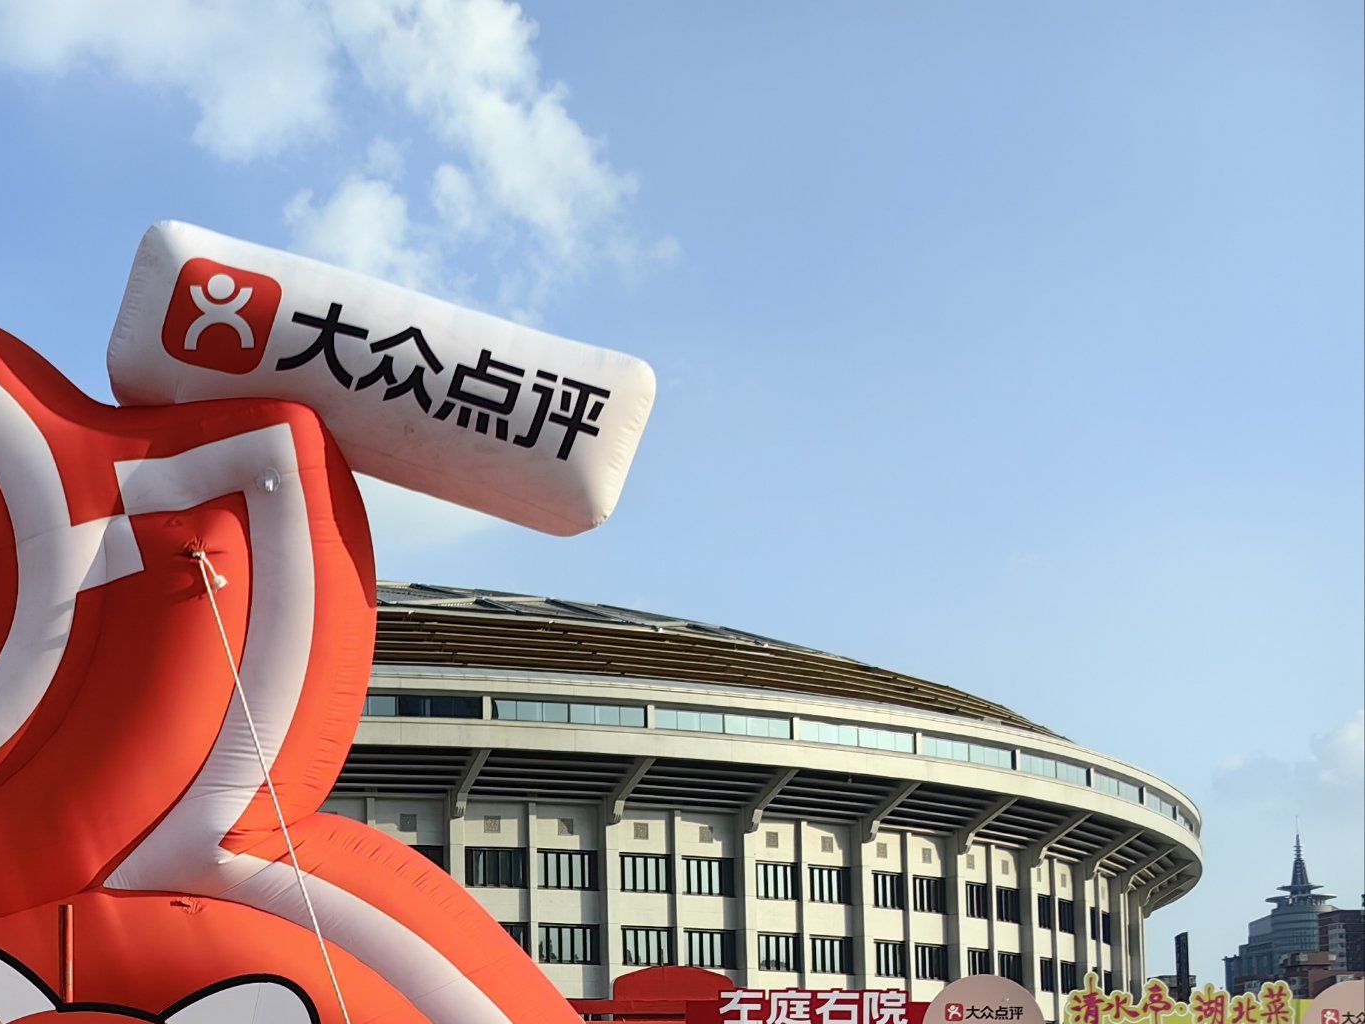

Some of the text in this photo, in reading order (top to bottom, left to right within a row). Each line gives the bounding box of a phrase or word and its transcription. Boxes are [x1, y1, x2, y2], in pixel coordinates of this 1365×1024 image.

[275, 302, 611, 461] 大众点评
[965, 1005, 1024, 1020] 大众点评
